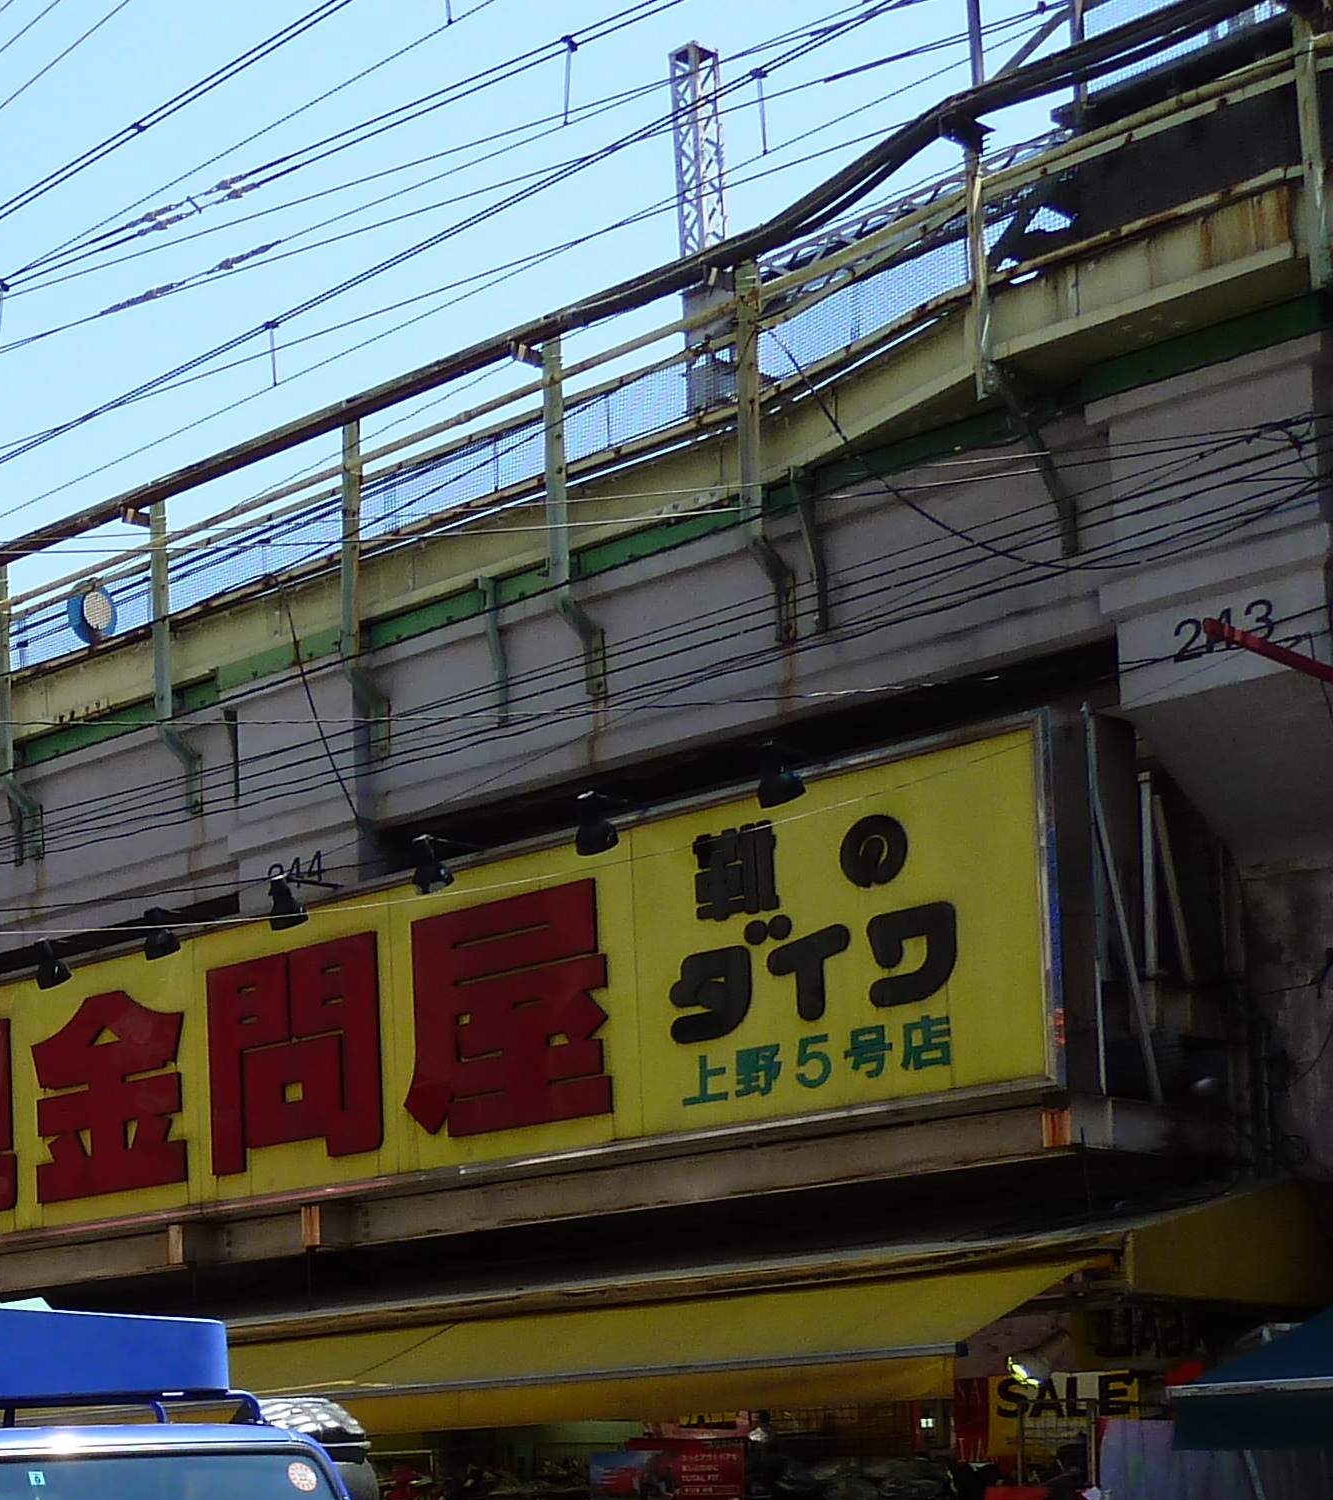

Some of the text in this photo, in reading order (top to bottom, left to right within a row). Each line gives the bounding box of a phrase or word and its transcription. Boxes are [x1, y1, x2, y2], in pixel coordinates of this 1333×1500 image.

[669, 901, 958, 1044] ダイワ
[683, 1015, 951, 1106] 上野5号店
[997, 1373, 1137, 1419] SALE
